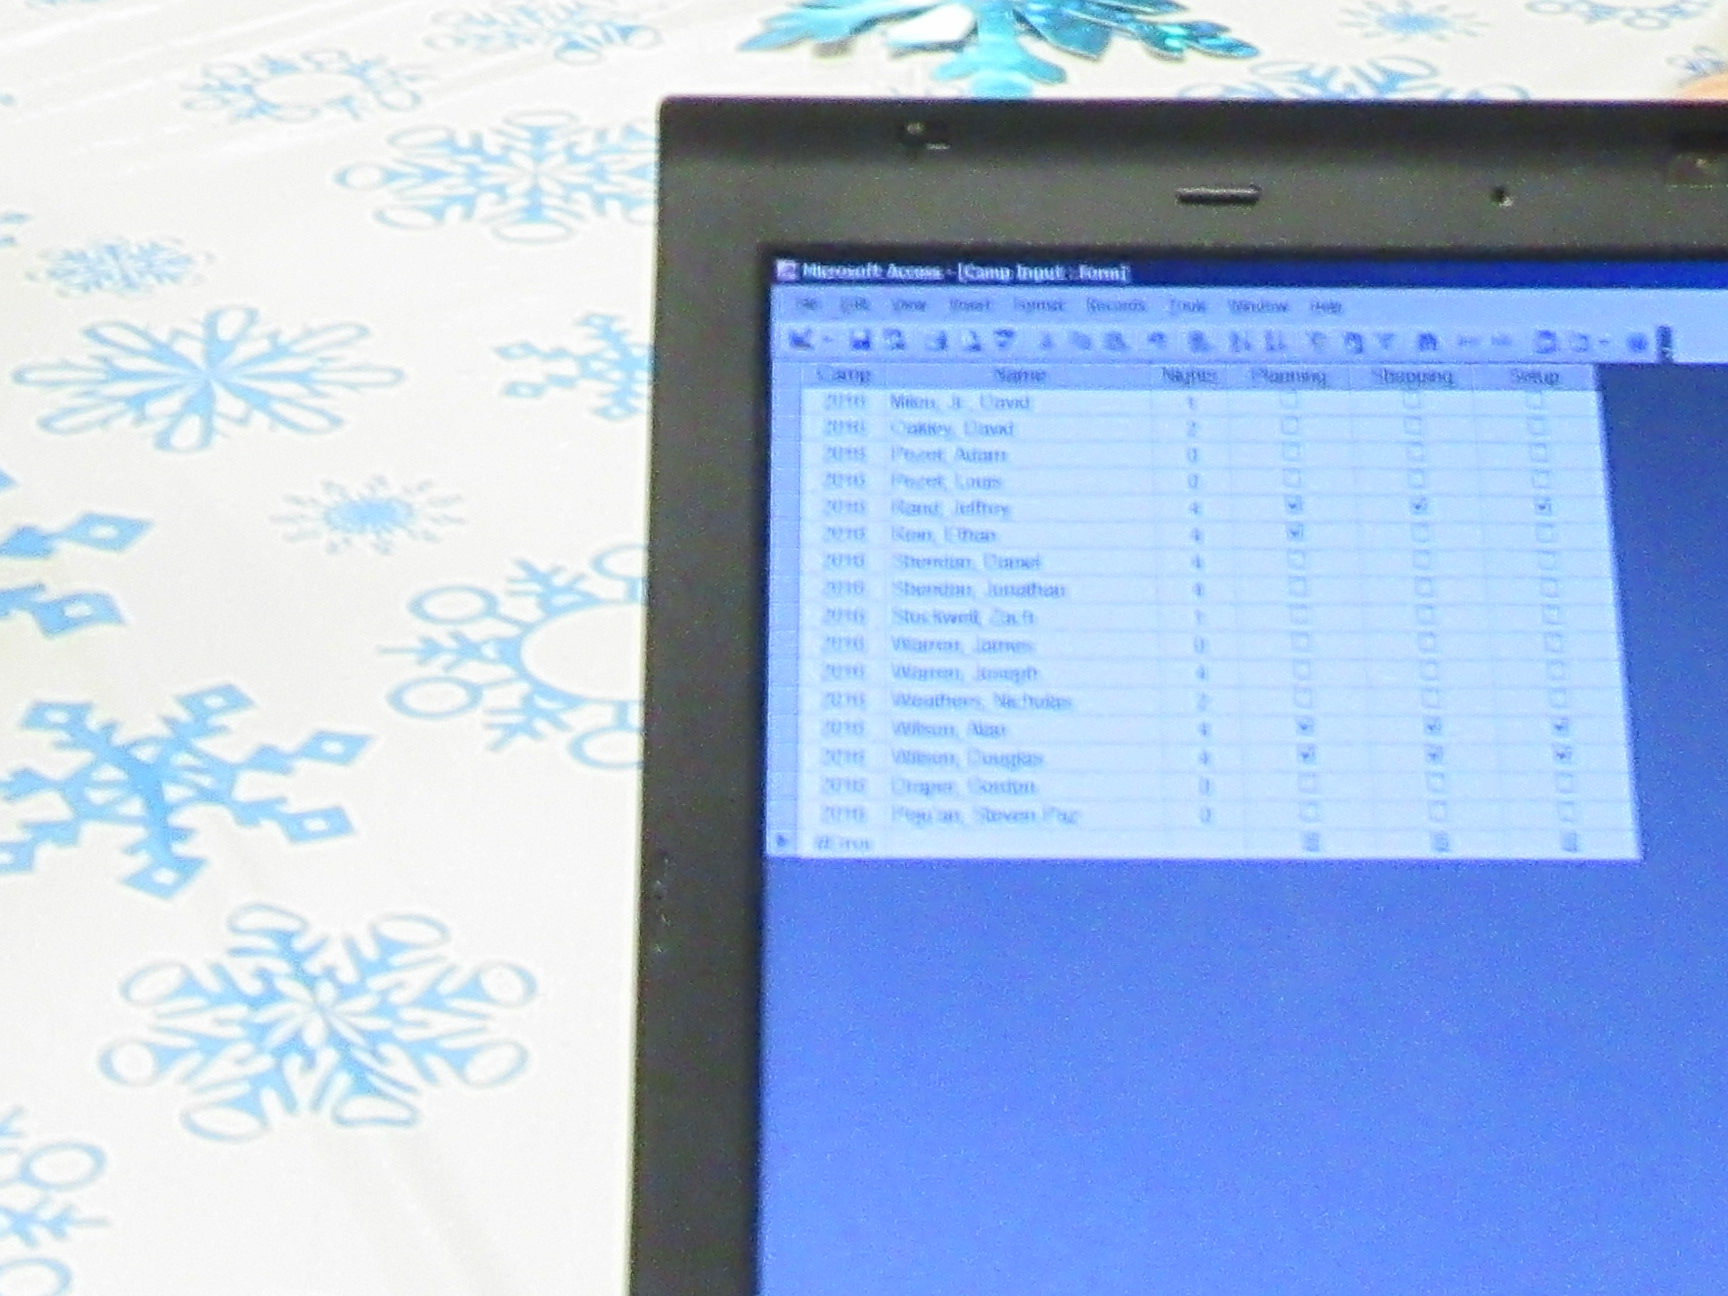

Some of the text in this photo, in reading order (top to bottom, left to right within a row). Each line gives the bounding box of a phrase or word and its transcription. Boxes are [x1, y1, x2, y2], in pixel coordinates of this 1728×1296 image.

[803, 263, 882, 280] Microsoft
[886, 264, 945, 280] Access
[993, 367, 1048, 384] Name
[978, 394, 1032, 410] David
[963, 421, 1015, 437] David
